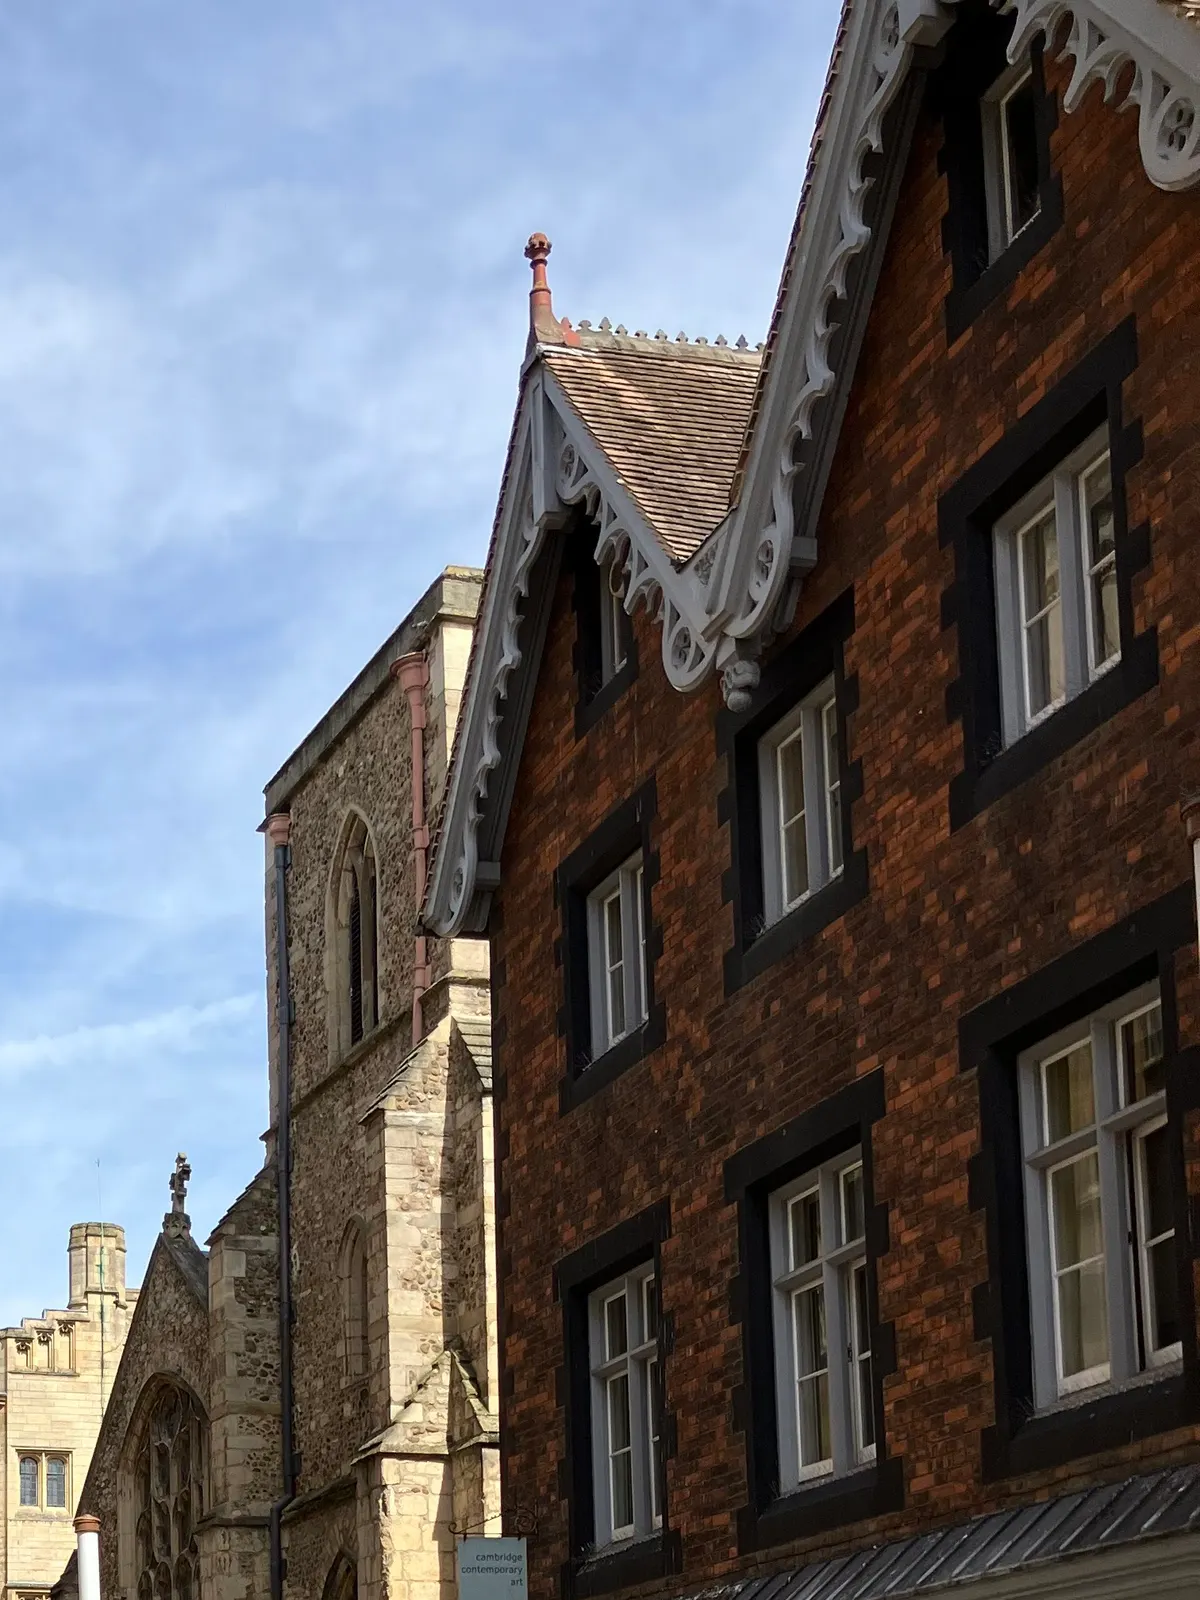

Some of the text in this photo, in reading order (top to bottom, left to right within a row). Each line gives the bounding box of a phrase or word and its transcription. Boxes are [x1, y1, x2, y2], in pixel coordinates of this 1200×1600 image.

[475, 1552, 523, 1564] cambridge
[461, 1565, 524, 1576] contemporary
[510, 1578, 524, 1587] art
